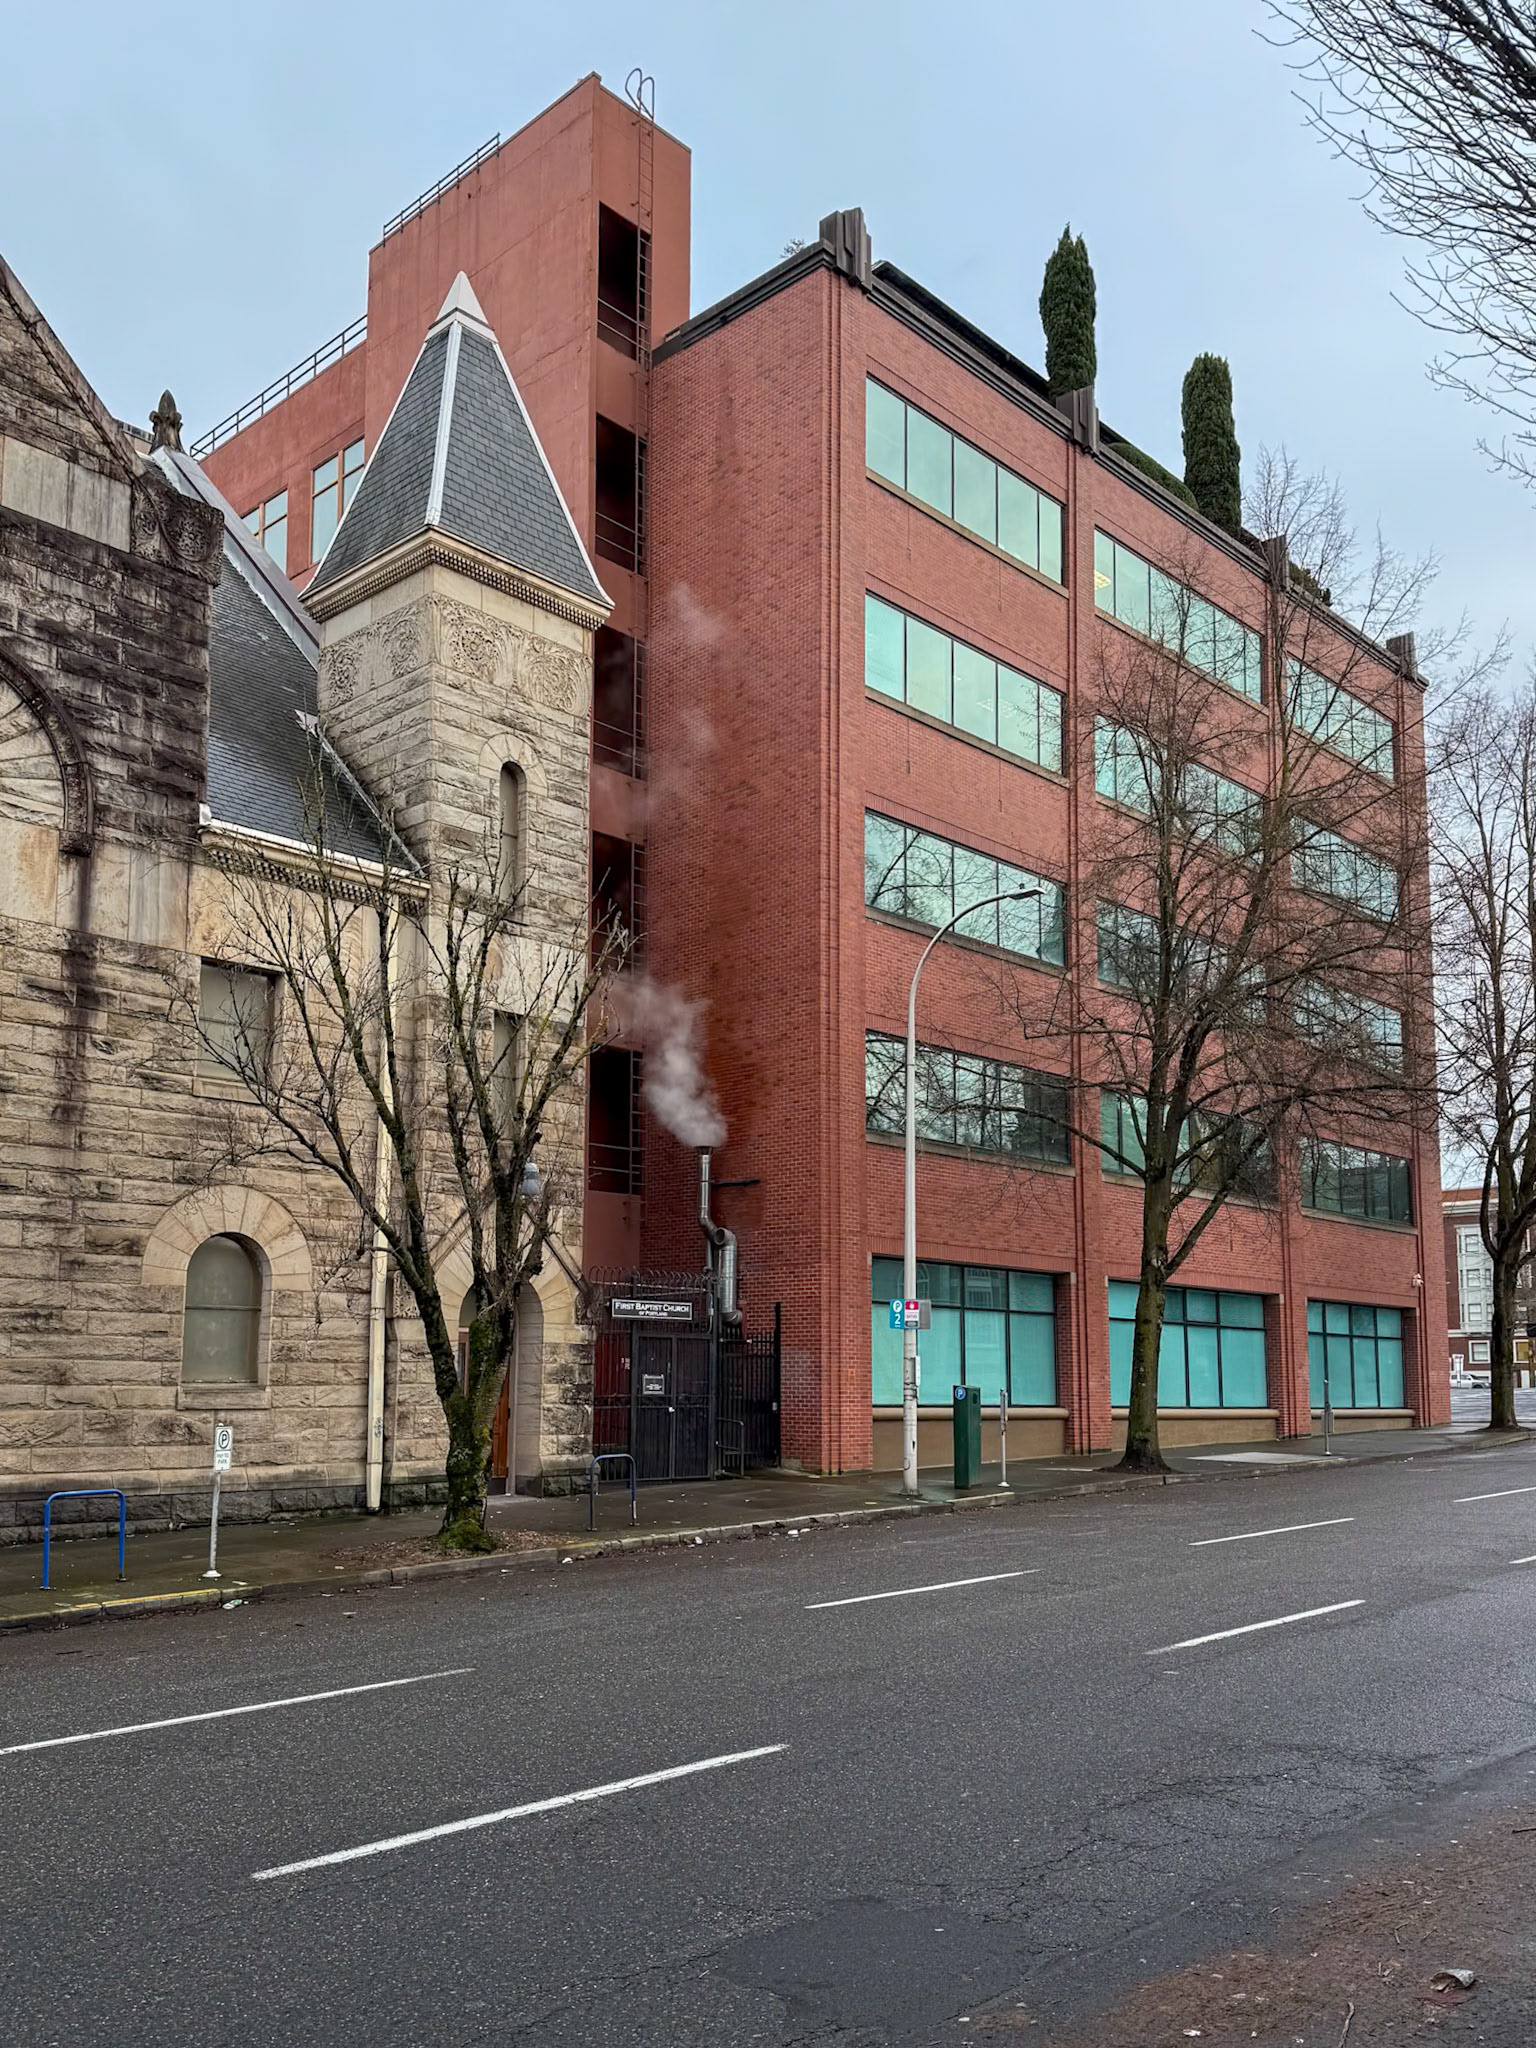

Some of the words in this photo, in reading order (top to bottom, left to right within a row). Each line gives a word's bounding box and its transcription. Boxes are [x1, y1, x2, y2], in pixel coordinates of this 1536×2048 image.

[615, 1302, 635, 1310] FIRST
[635, 1303, 662, 1312] BAPTIST
[663, 1304, 689, 1313] CHURCH
[894, 1313, 901, 1325] 2
[221, 1433, 227, 1446] P
